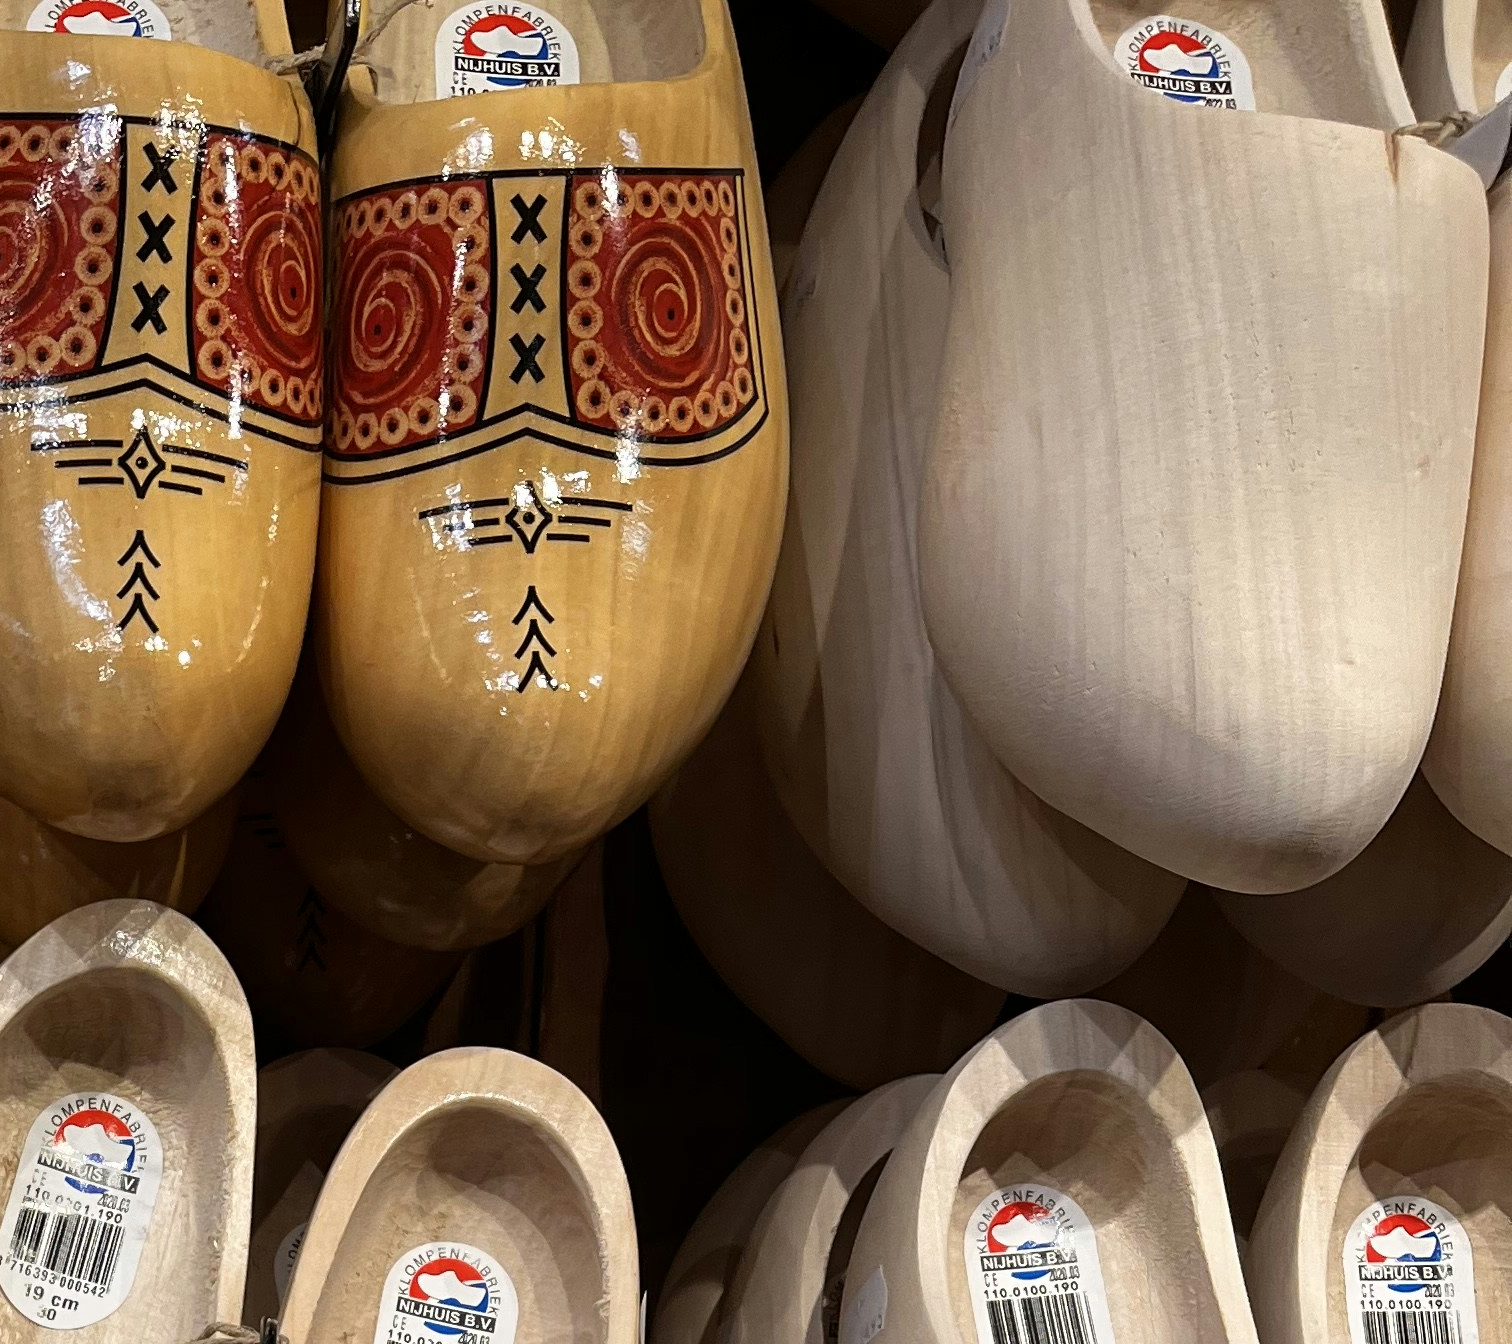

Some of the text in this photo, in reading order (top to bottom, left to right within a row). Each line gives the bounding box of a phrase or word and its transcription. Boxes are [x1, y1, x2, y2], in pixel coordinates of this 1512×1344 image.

[454, 5, 560, 61] KLOMPENFABRIEK
[1129, 21, 1231, 79] KLOMPENFABRIEK
[458, 59, 558, 76] NIJHUIS B.V.
[984, 1252, 1045, 1270] NIJHUIS
[984, 1281, 1078, 1299] 110.0100.190
[52, 1293, 79, 1312] cm
[399, 1300, 493, 1331] NIJHUIS B.V.
